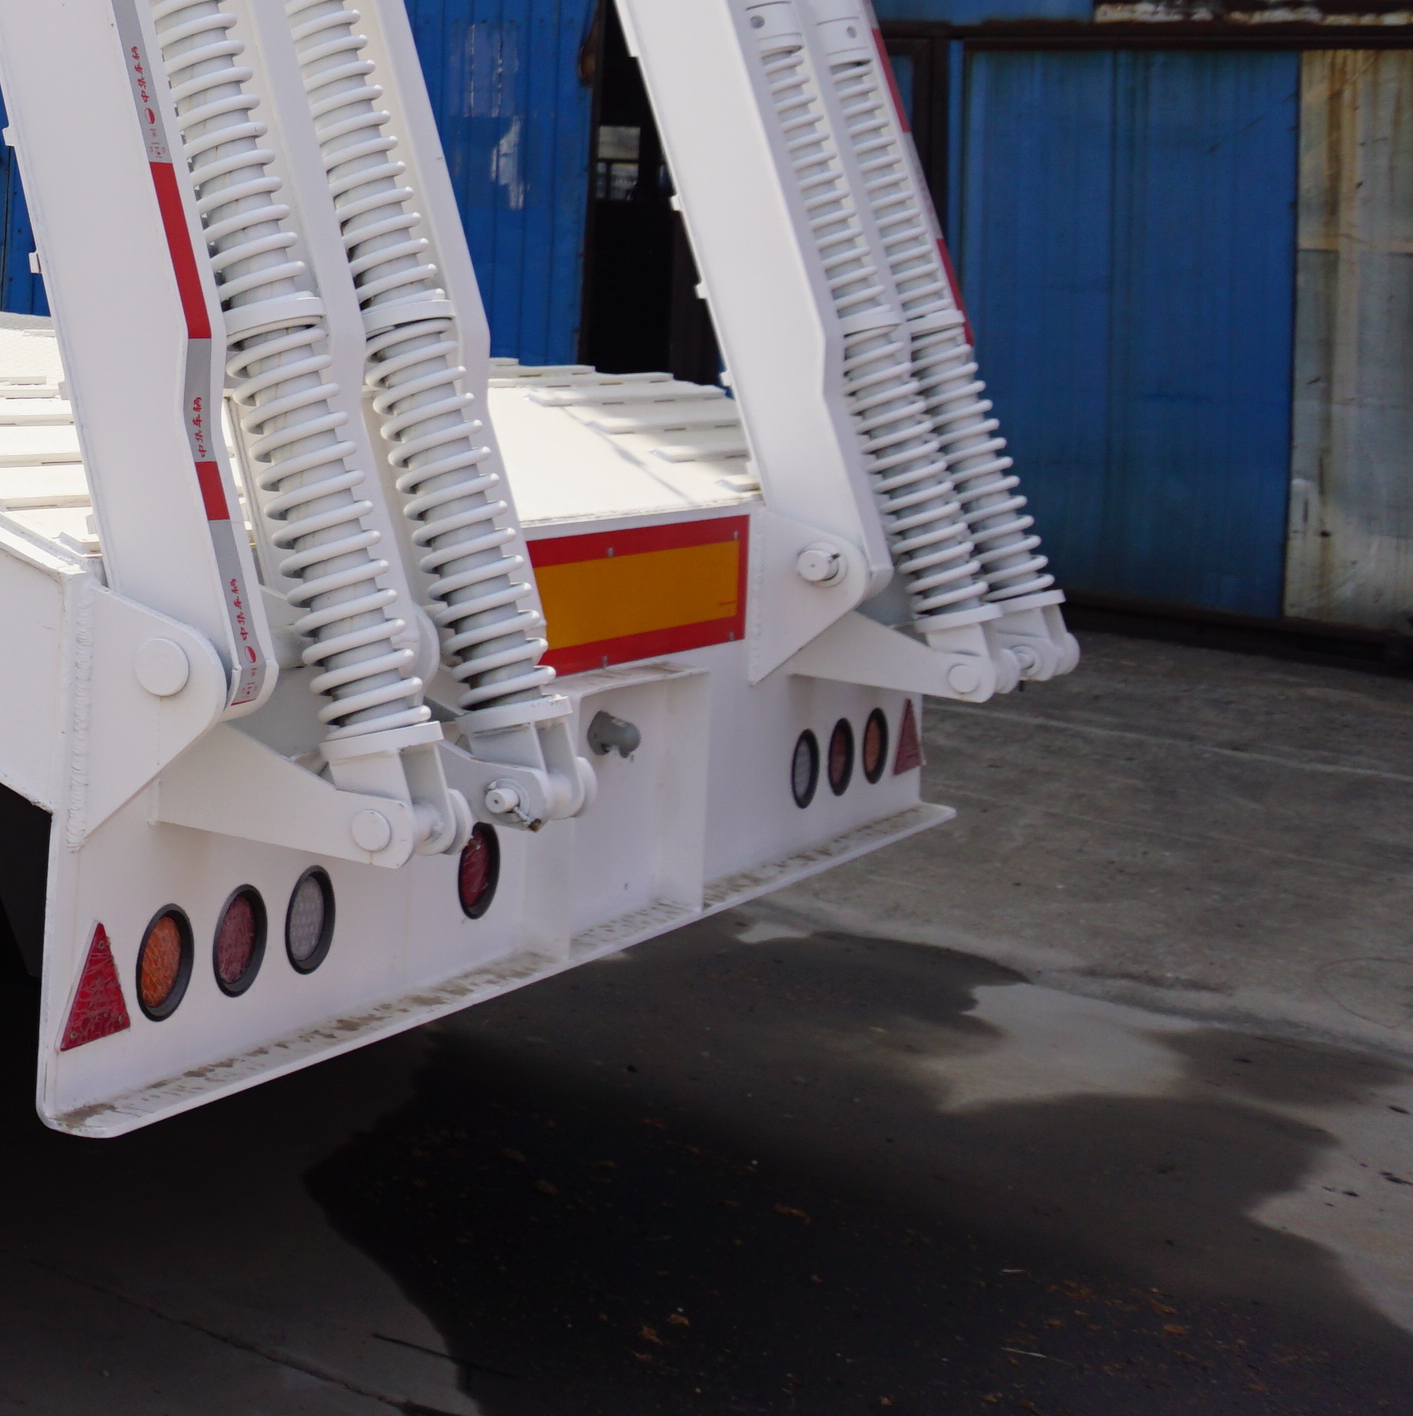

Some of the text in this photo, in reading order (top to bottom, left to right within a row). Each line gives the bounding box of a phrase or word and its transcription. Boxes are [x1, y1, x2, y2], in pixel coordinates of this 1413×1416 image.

[131, 46, 149, 102] 中集车辆
[192, 396, 207, 458] 中集车辆
[230, 578, 248, 641] 中集车辆
